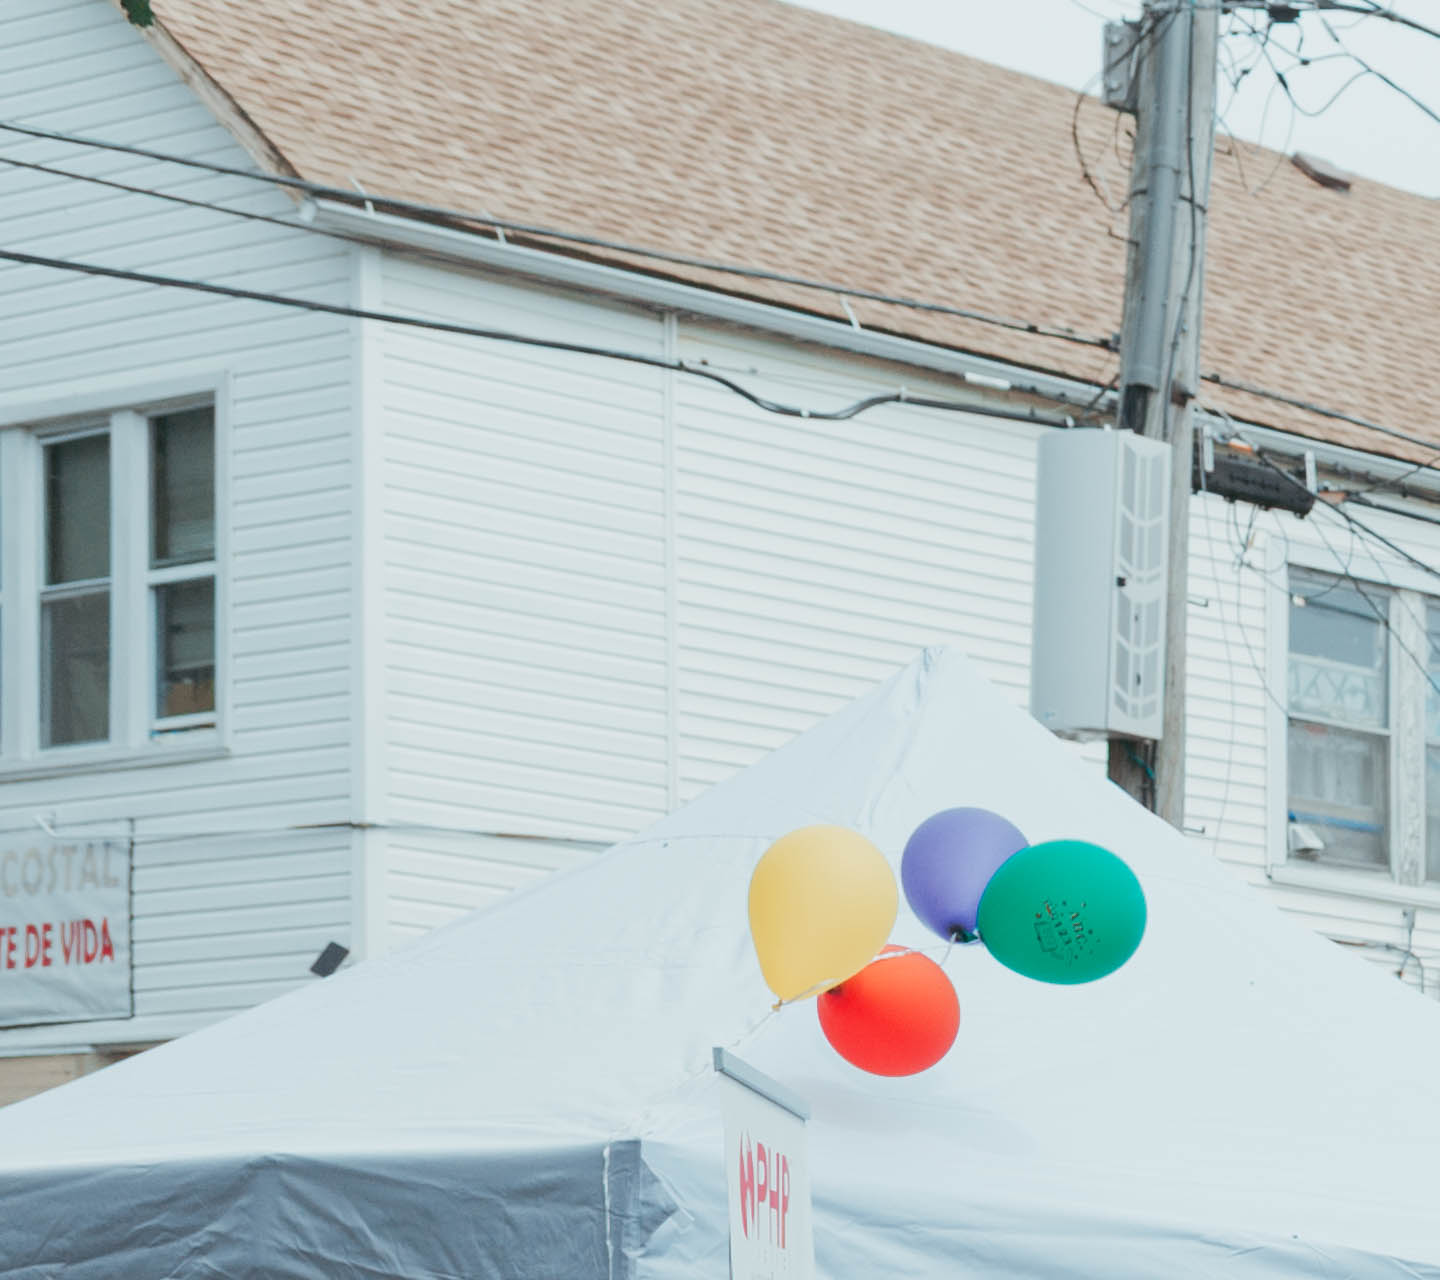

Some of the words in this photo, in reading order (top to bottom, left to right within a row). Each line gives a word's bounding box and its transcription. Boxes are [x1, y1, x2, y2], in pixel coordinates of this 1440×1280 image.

[25, 922, 52, 969] DE
[60, 916, 115, 966] VIDA
[756, 1141, 790, 1249] PHP
